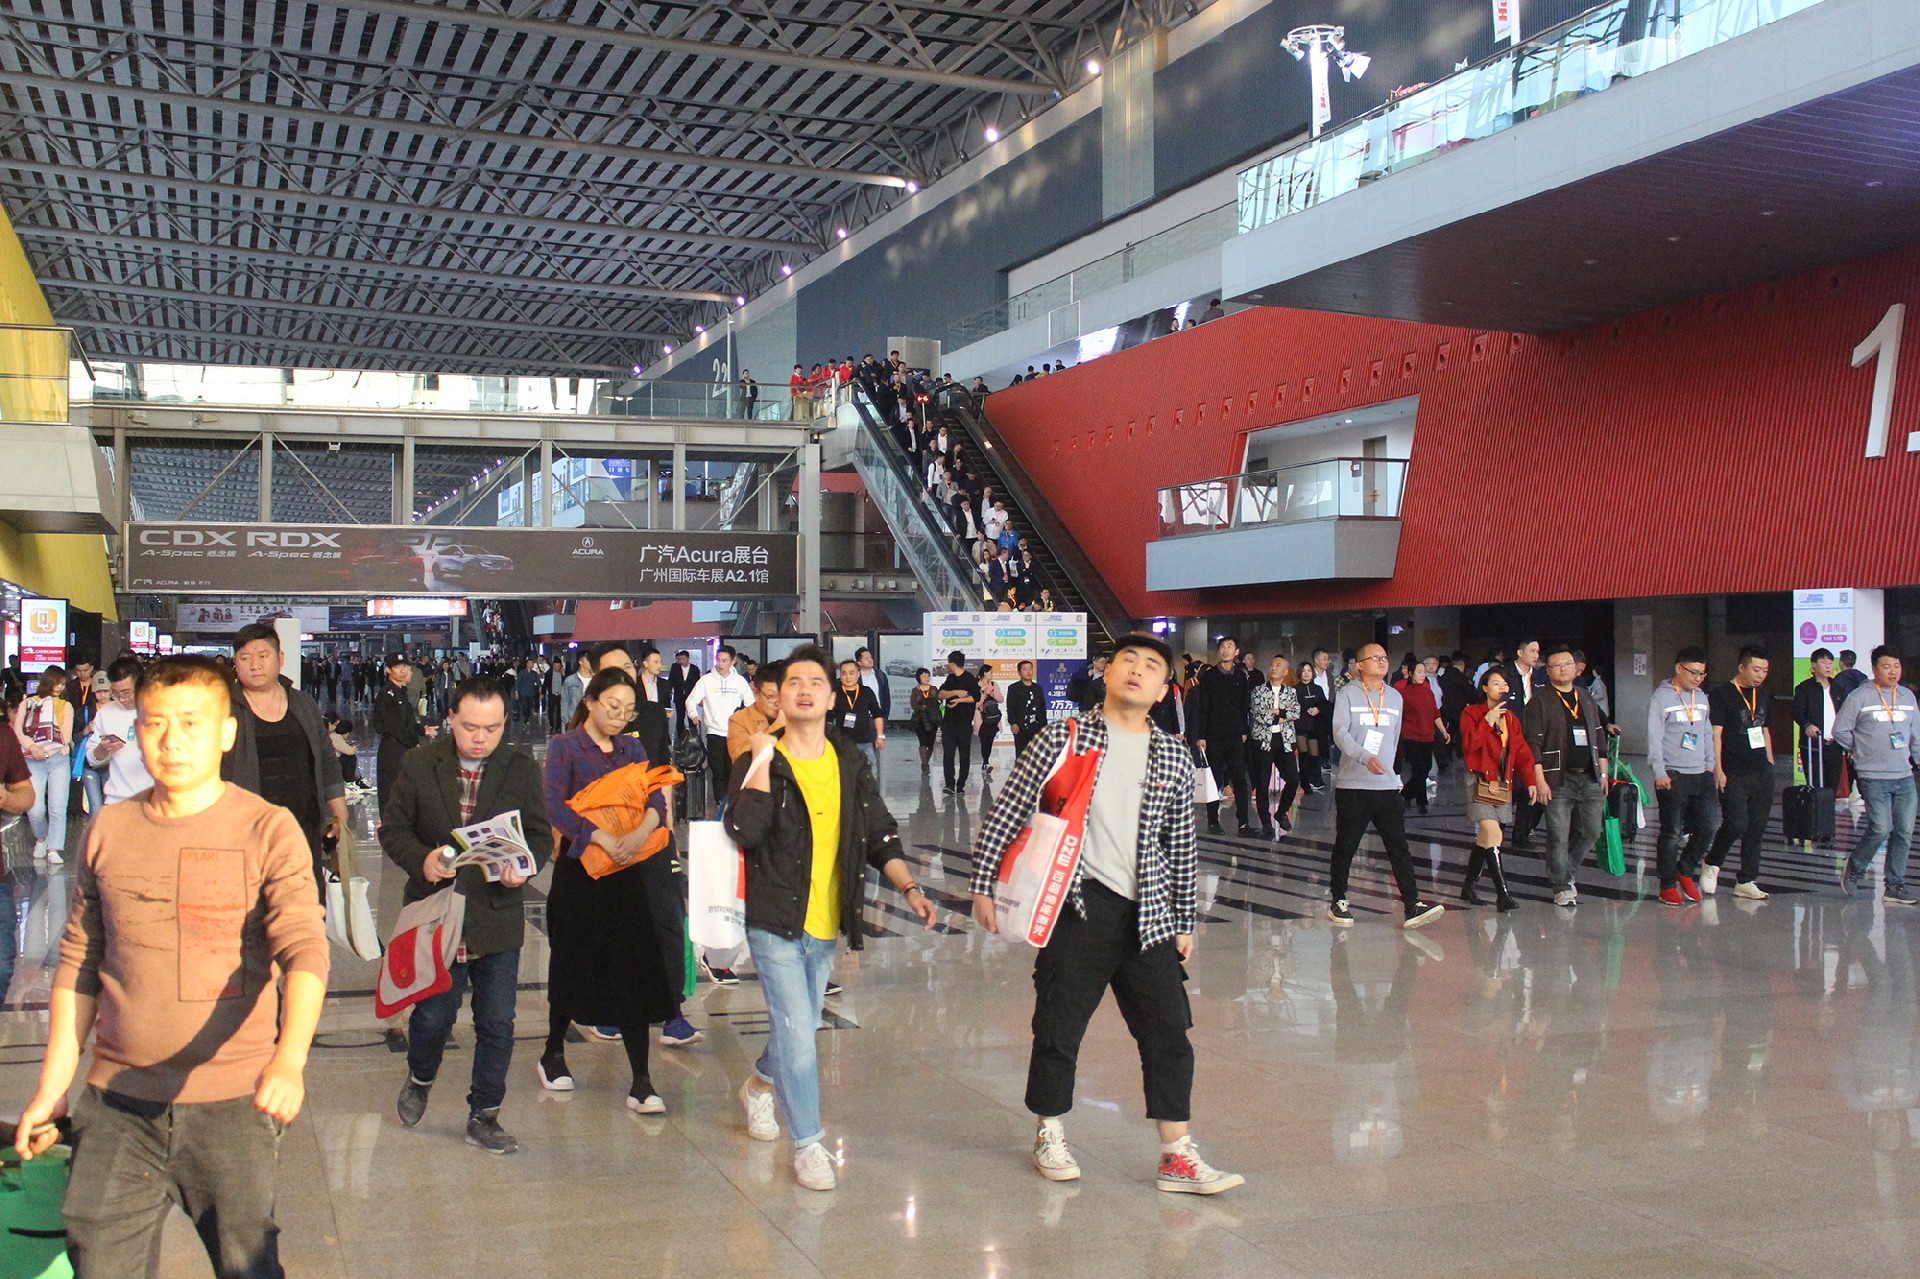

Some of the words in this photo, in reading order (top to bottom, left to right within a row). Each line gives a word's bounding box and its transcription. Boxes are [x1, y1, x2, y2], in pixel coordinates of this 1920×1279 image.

[139, 530, 237, 546] CDX
[247, 532, 342, 548] RDX
[139, 549, 203, 558] A-Spec
[247, 550, 310, 559] A-Spec
[572, 548, 604, 556] ACURA
[639, 544, 769, 565] 广汽Acura展台
[639, 567, 769, 583] 广州国际车展A2.1馆
